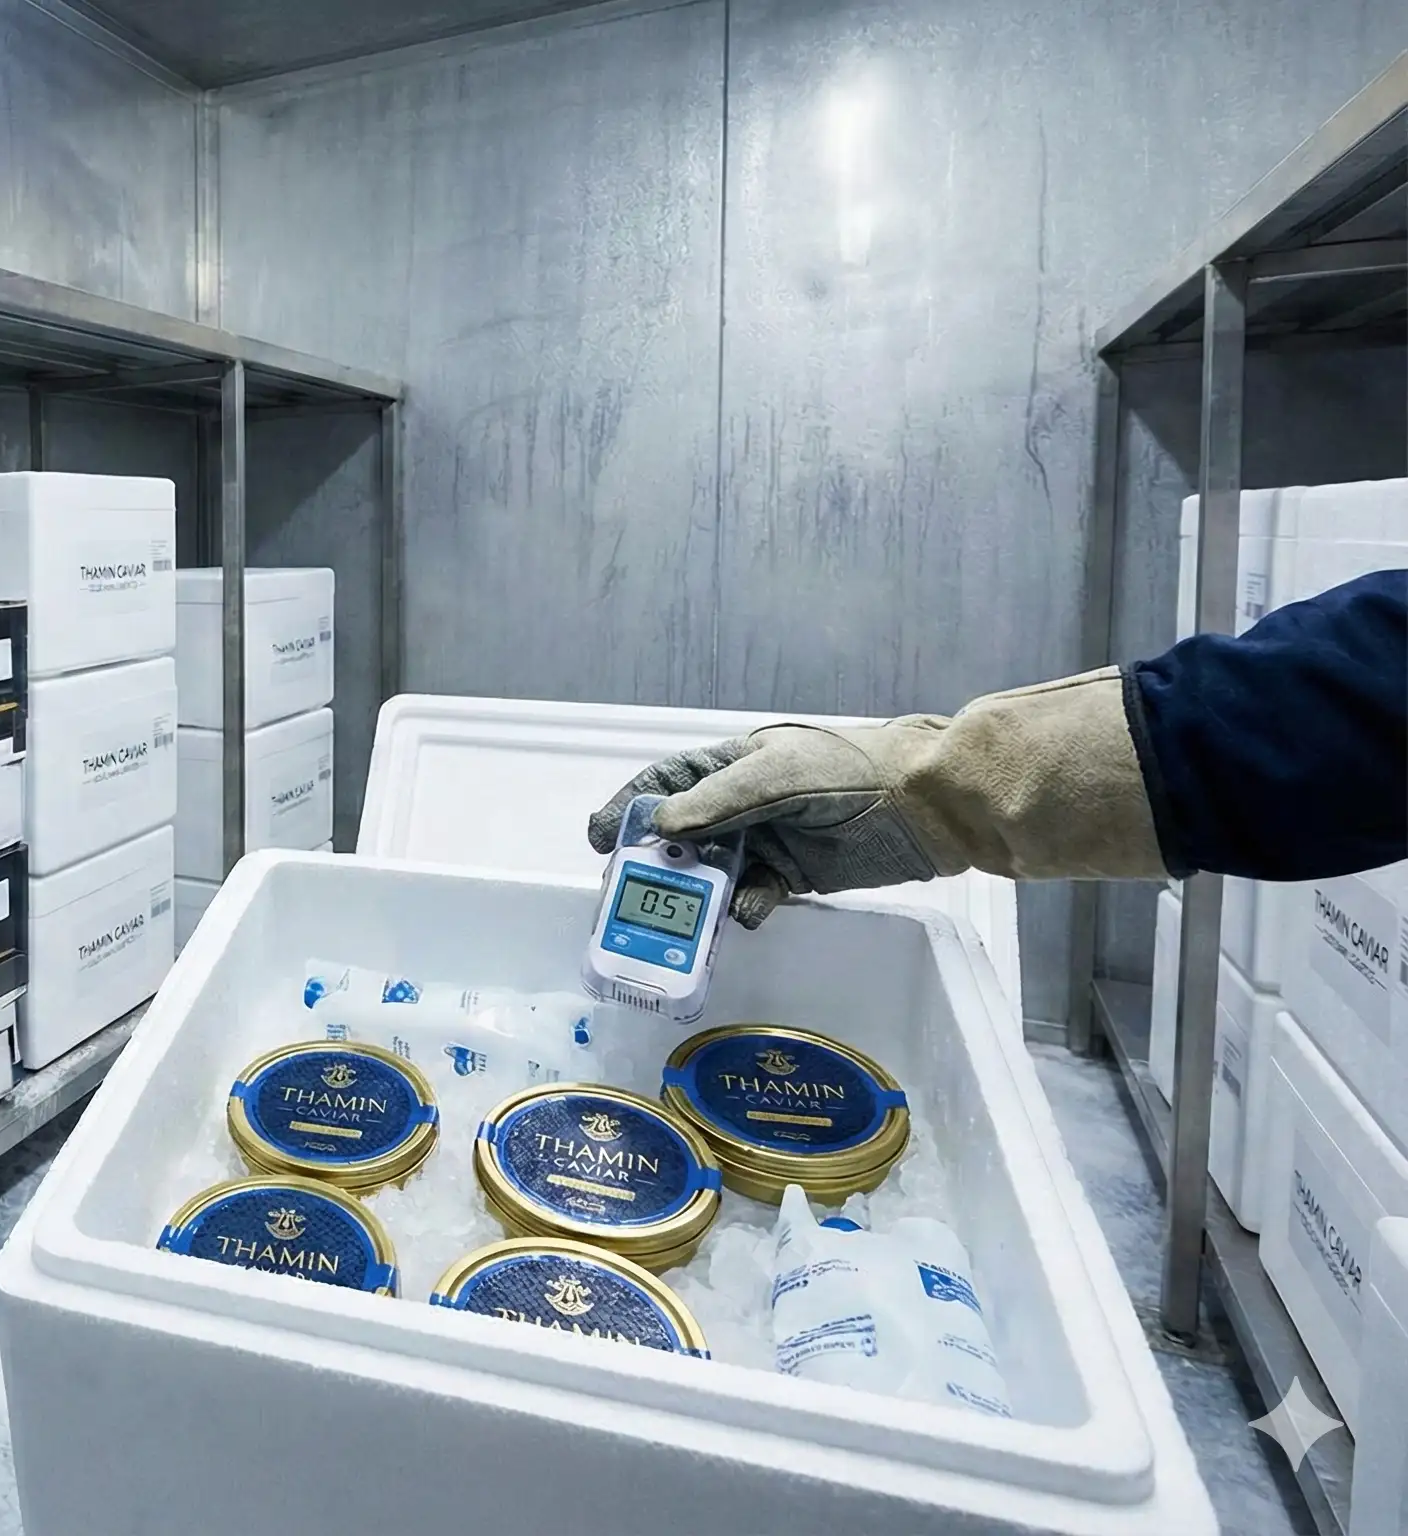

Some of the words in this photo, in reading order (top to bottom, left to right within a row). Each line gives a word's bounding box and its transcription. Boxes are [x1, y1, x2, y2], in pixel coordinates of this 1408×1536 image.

[639, 889, 681, 920] 0.5
[280, 1086, 388, 1114] THAMIN
[718, 1074, 845, 1100] THAMIN
[295, 1105, 361, 1124] CAVIAR
[746, 1094, 823, 1110] CAVIAR
[534, 1132, 659, 1175] THAMIN
[553, 1157, 630, 1183] CAVIAR
[216, 1236, 340, 1275] THAMIN
